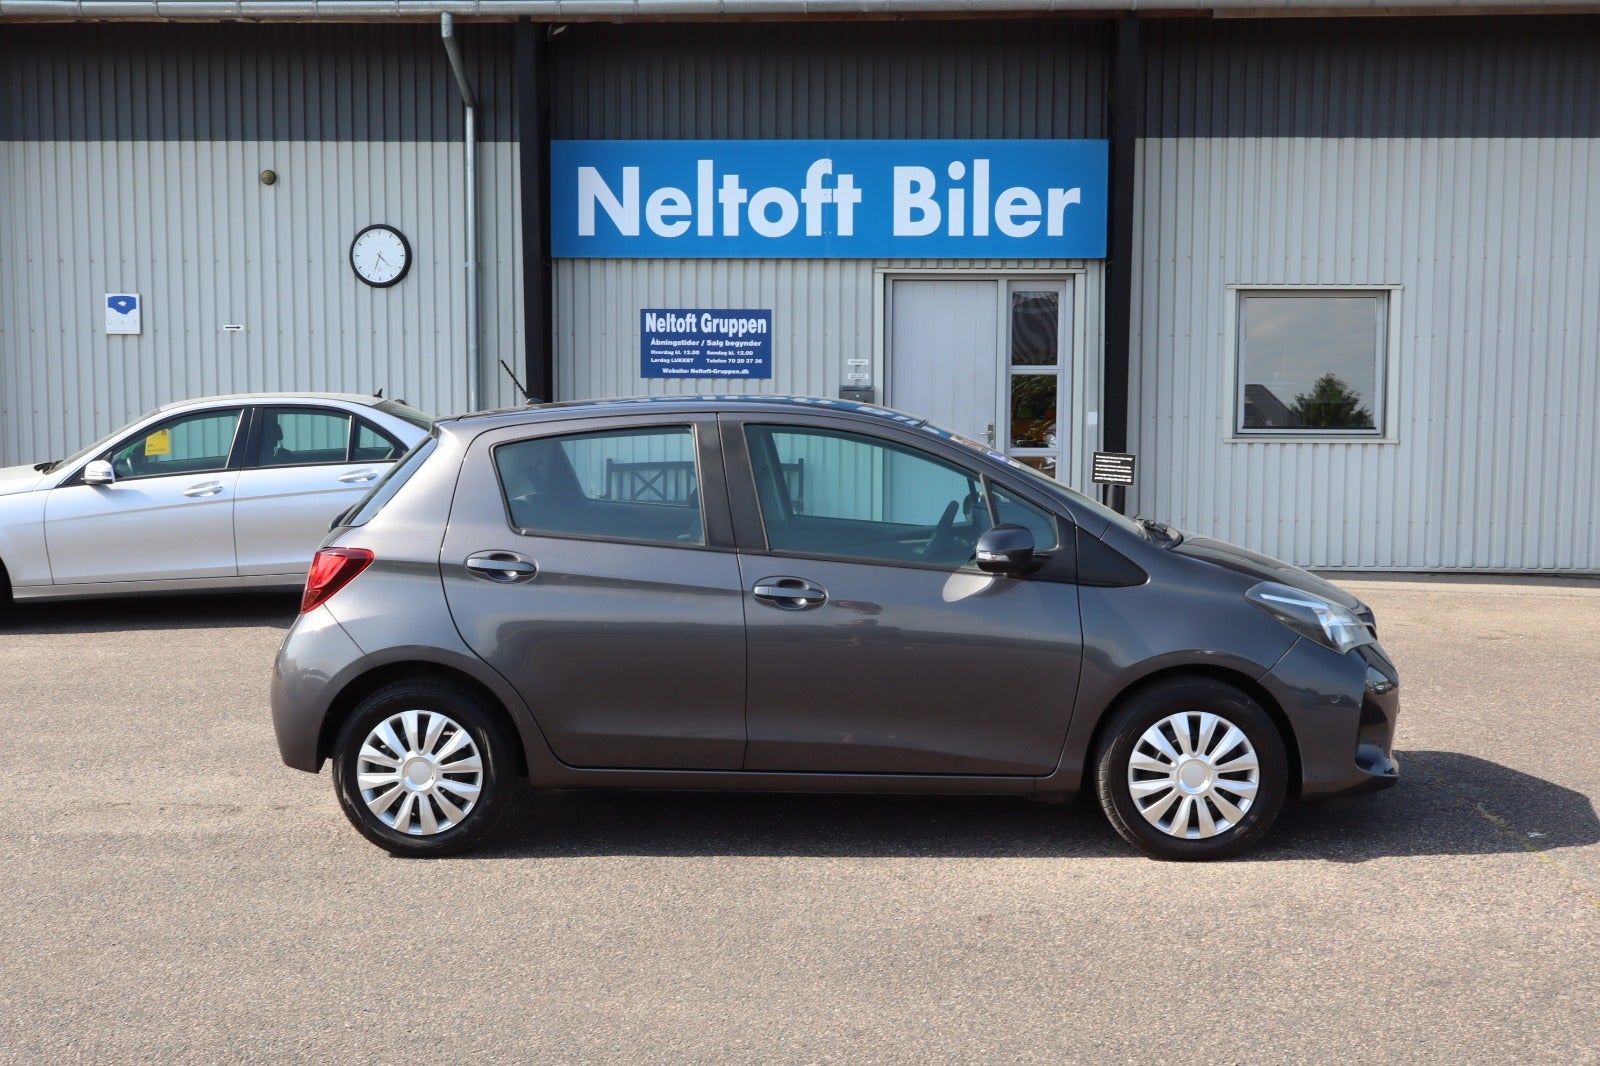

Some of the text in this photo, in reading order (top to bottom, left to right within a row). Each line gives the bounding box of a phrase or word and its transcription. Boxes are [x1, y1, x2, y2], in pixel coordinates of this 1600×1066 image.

[577, 158, 1081, 238] Neltoft Biler
[645, 312, 767, 338] Neltoft Gruppen
[650, 337, 700, 348] Åbningstider
[706, 339, 724, 348] Salg
[725, 340, 762, 348] begynder
